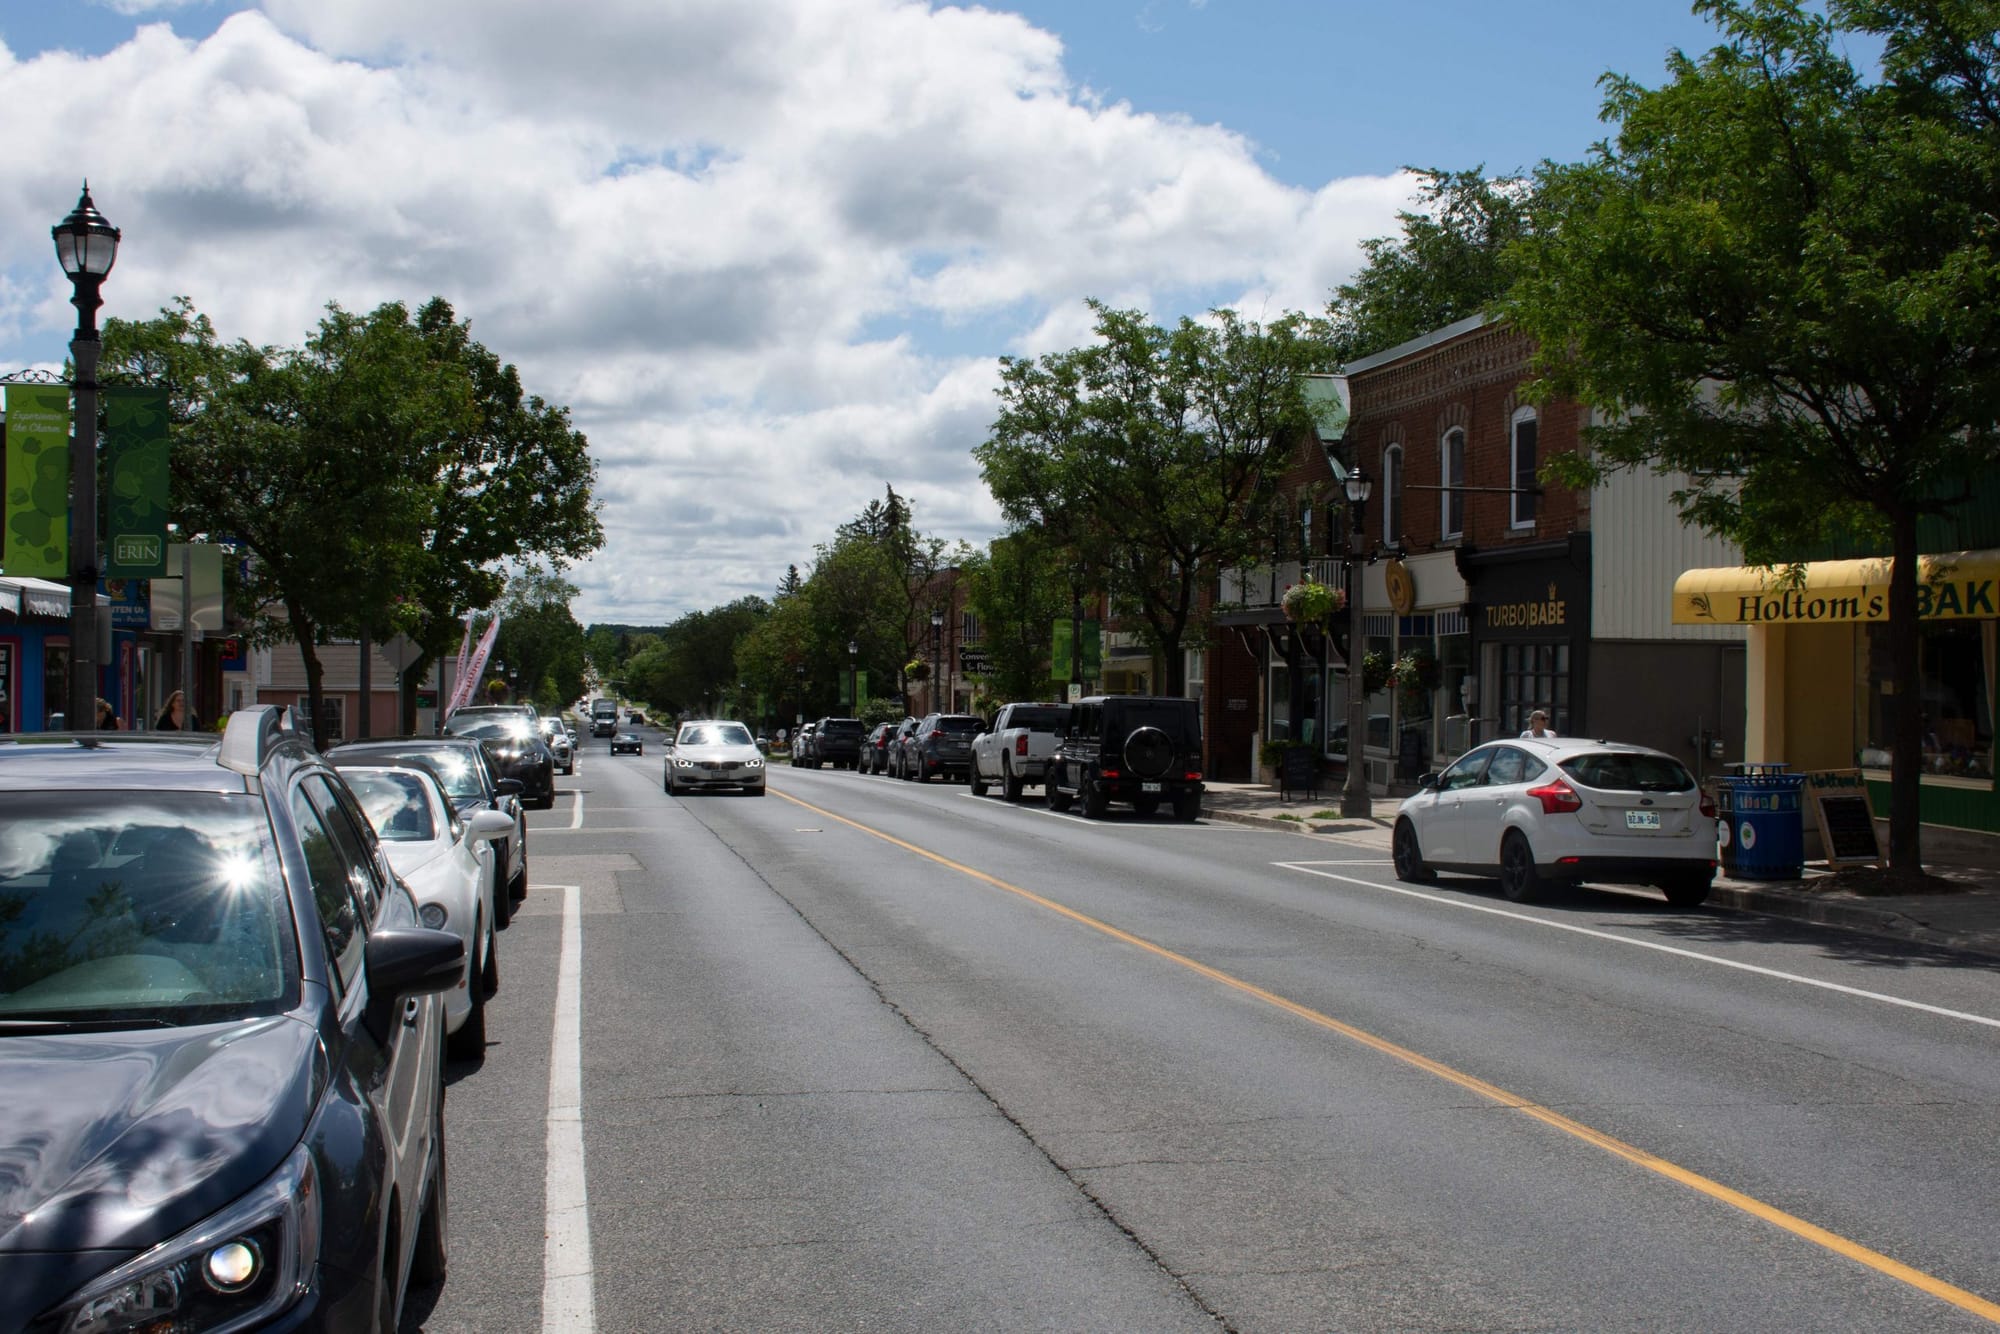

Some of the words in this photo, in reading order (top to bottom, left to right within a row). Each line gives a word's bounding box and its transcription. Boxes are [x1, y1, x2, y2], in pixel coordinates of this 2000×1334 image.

[117, 544, 158, 559] ERIN
[1735, 586, 1884, 622] Holtom's
[1916, 580, 2000, 615] BAK
